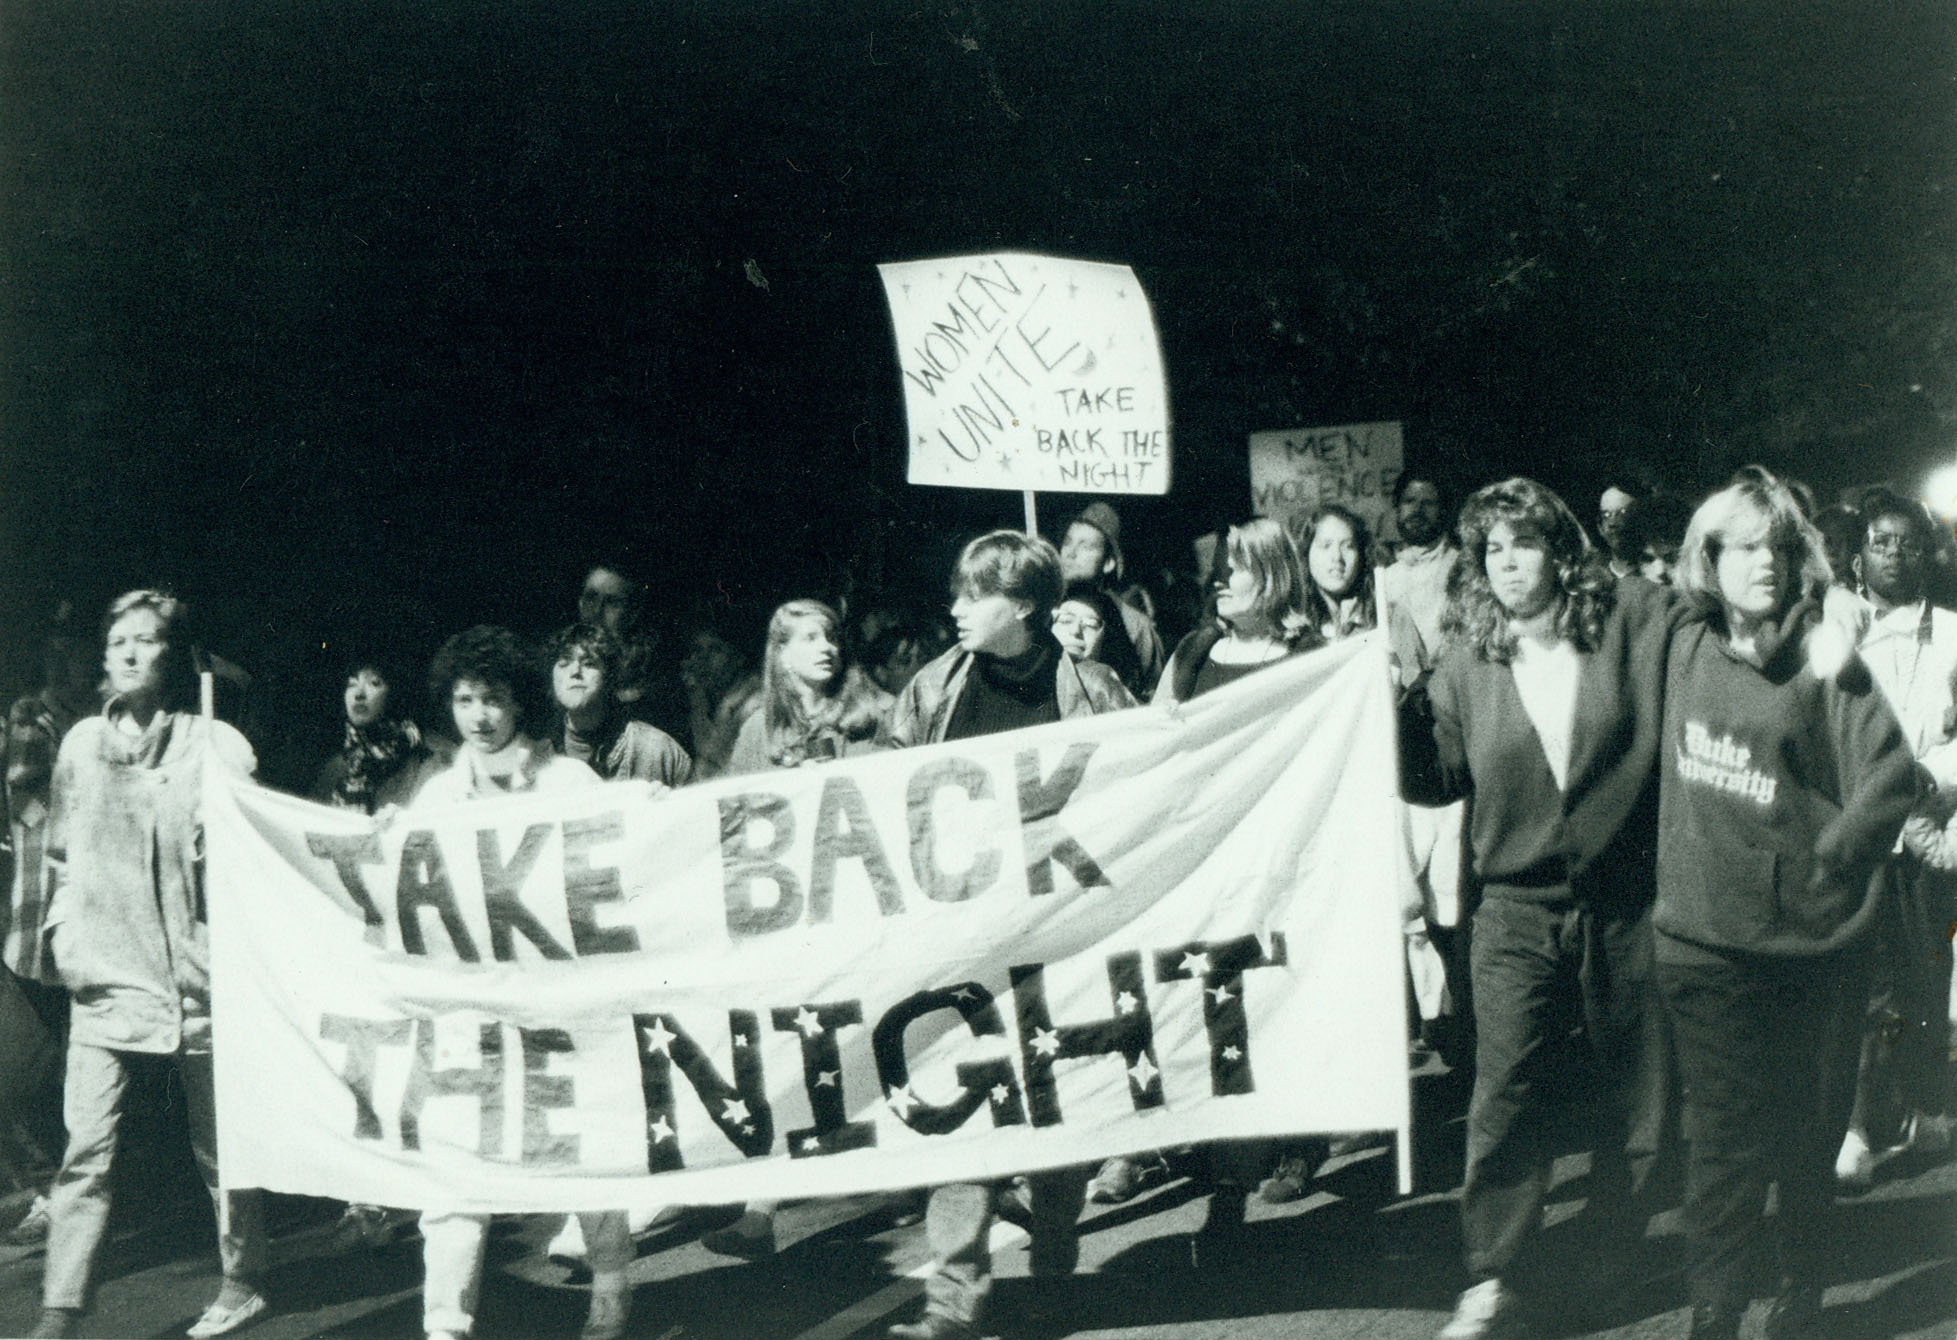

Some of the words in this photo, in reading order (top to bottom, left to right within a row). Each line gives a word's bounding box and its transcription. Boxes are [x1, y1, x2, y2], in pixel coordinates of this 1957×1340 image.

[905, 258, 1021, 397] WOMEN
[937, 282, 1081, 463] UNITE
[1055, 387, 1135, 417] TAKE
[1037, 427, 1109, 459] BACK
[1121, 429, 1163, 457] THE
[1059, 460, 1153, 488] NIGHT
[1284, 429, 1373, 466] MEN
[306, 810, 641, 963] TAKE
[717, 742, 1112, 939] BACK
[319, 1012, 582, 1165] THE
[632, 931, 1287, 1174] NIGHT
